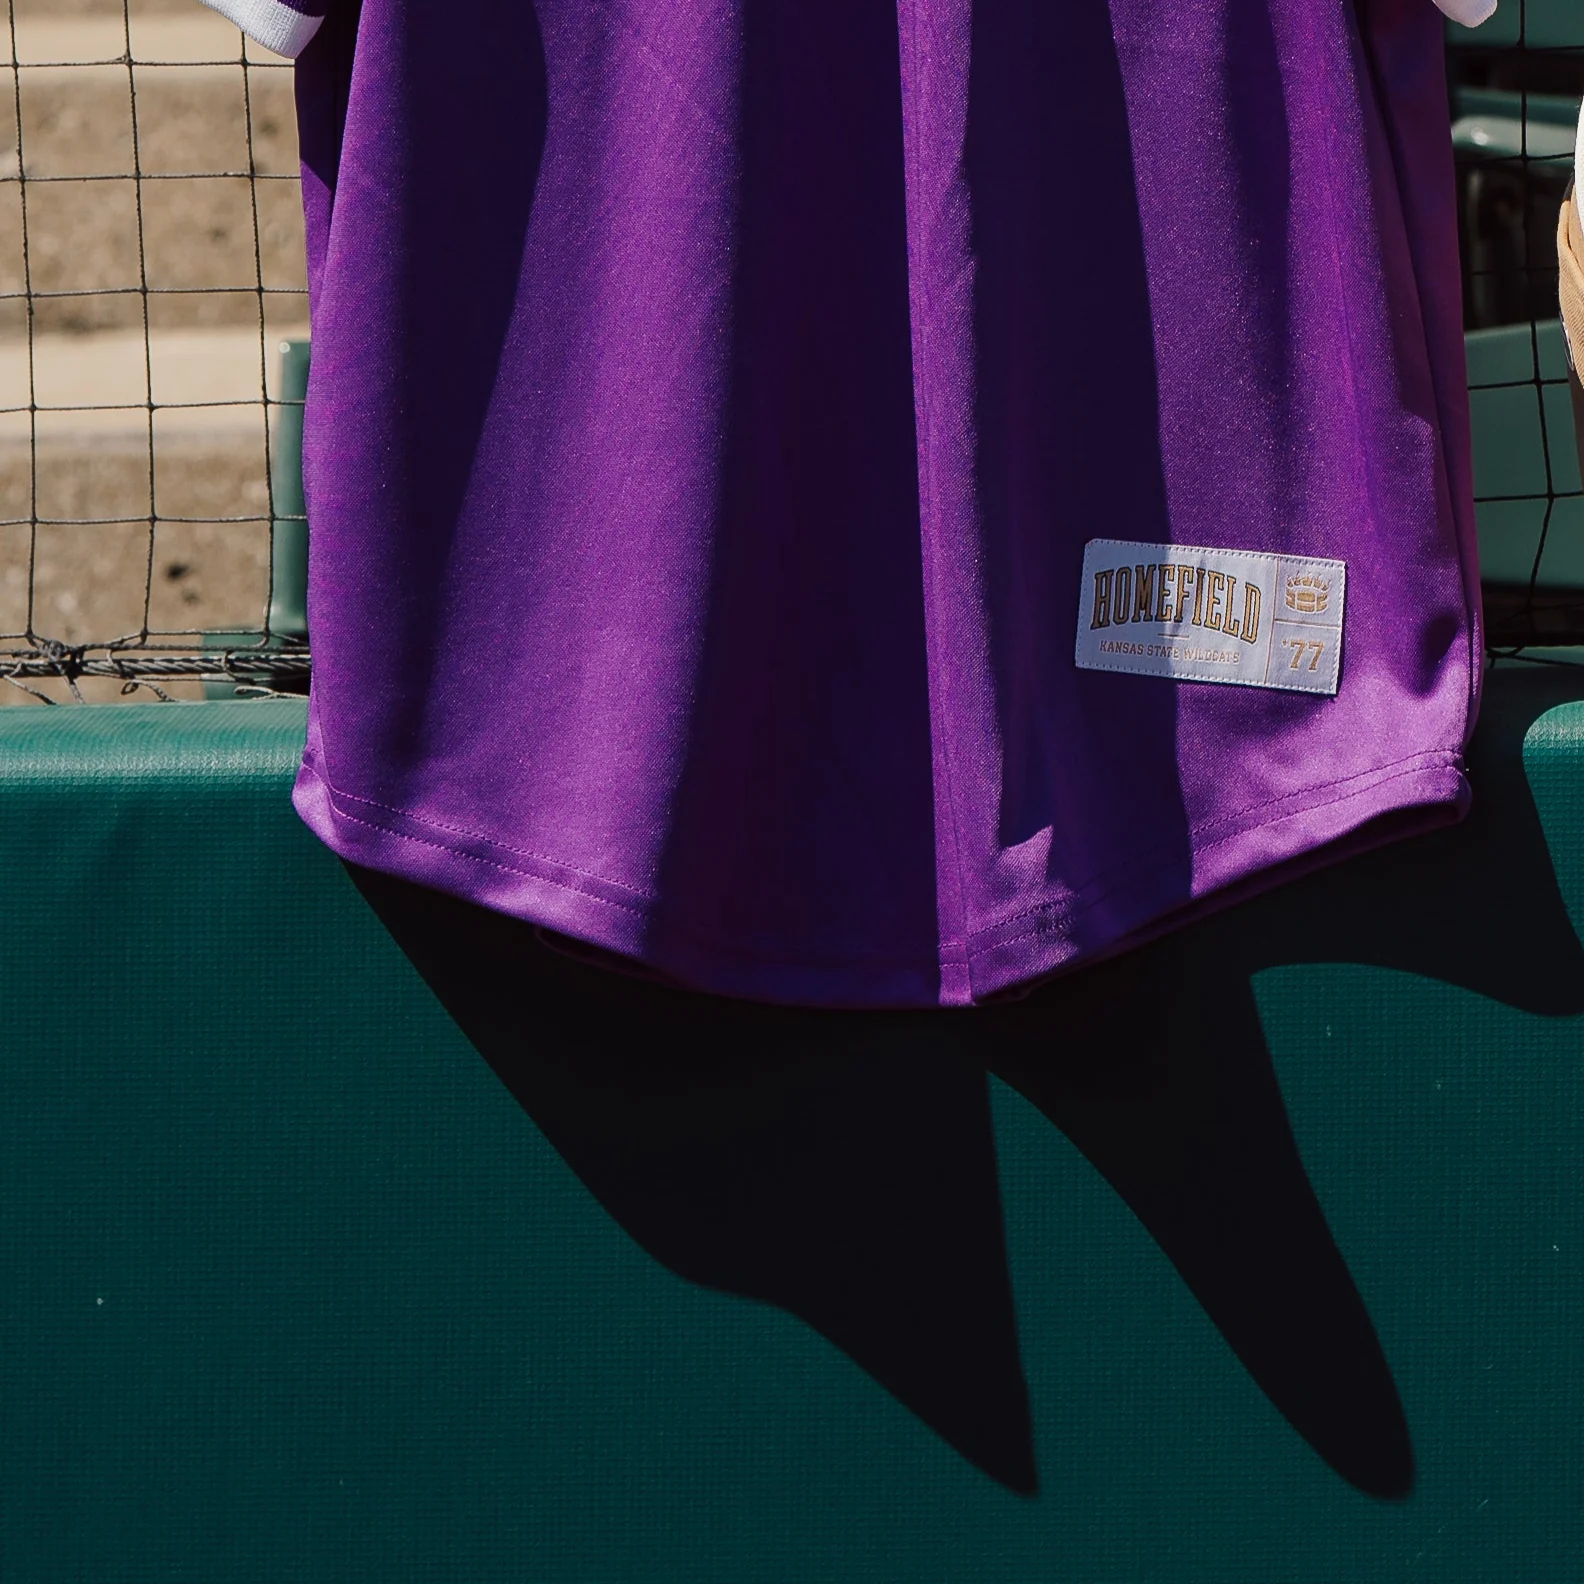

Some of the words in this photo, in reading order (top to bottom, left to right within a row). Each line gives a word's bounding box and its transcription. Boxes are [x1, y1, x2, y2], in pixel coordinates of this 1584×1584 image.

[1090, 563, 1262, 644] HOMEFIELD
[1099, 640, 1145, 656] KANSAS
[1147, 644, 1179, 659] STATE
[1183, 647, 1240, 663] WILDCATS
